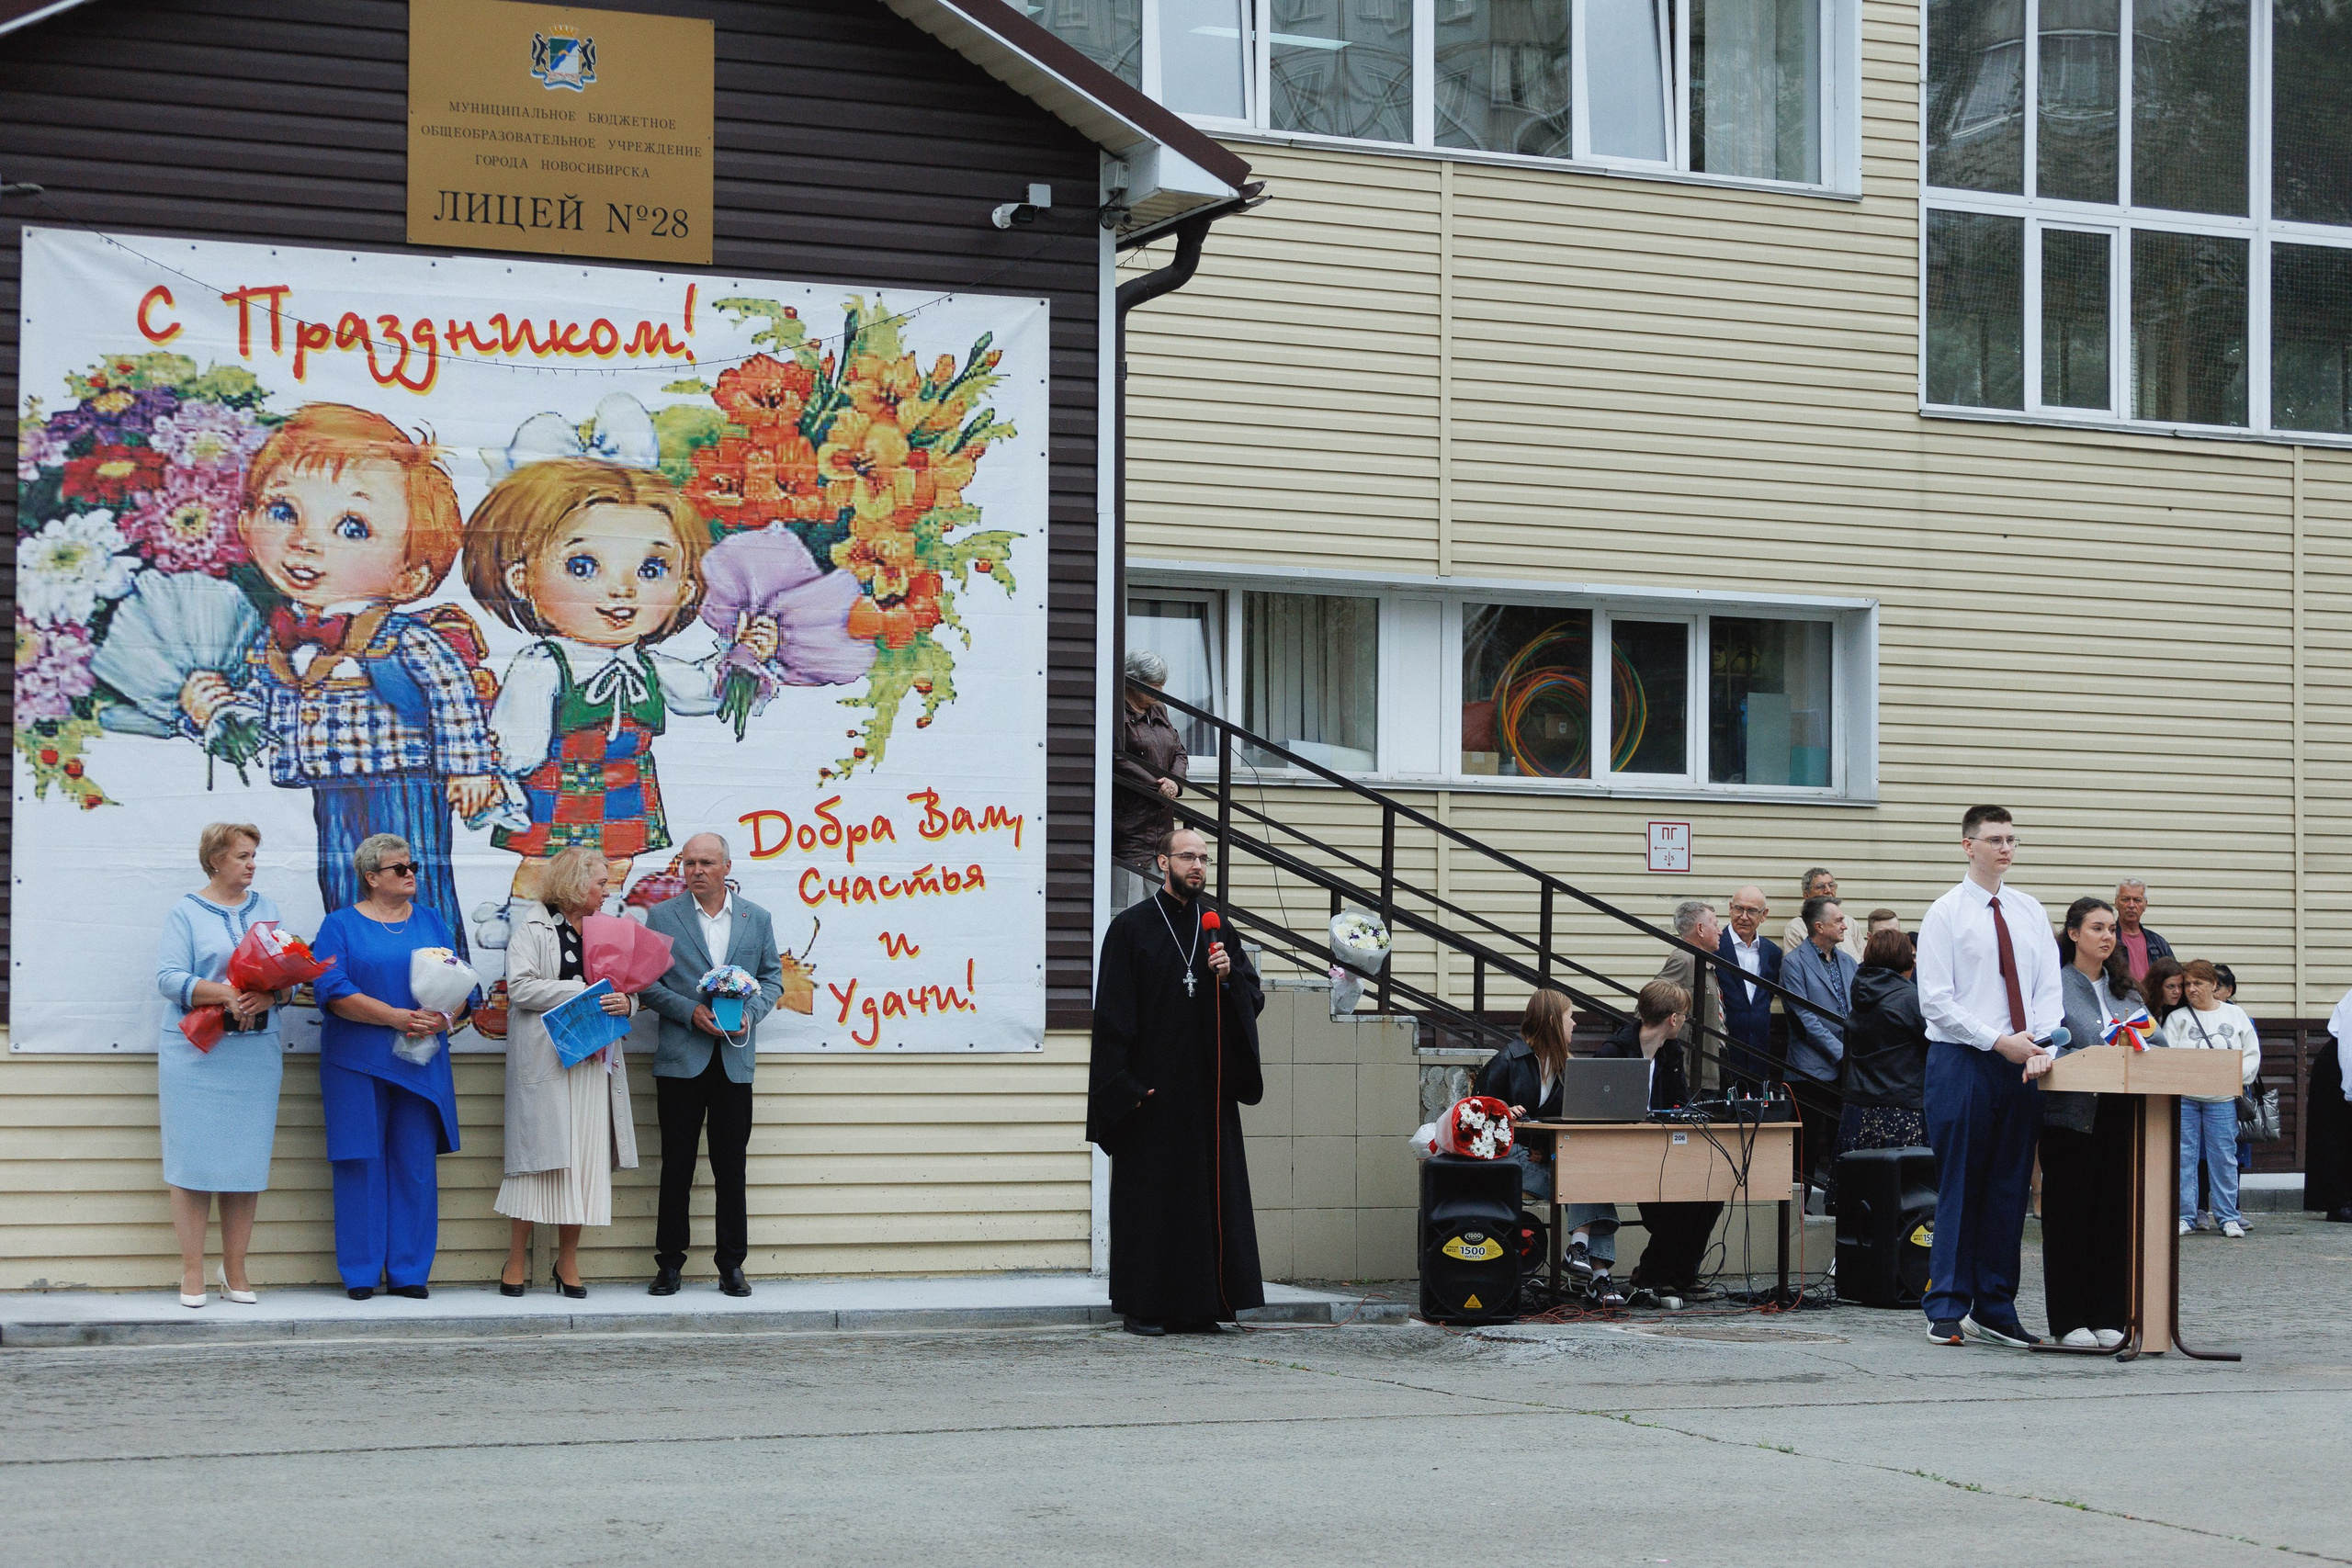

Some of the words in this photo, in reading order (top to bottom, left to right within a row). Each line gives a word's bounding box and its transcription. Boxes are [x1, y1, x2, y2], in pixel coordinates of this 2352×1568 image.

[449, 101, 576, 121] МУНИЦИПАЛЬНОЕ
[588, 112, 676, 130] БЮДЖЕТНОЕ
[421, 125, 596, 149] ОБЩЕОБРАЗОВАТЕЛЬНОЕ
[608, 140, 702, 157] УЧРЕЖДЕНИЕ
[476, 154, 528, 169] ГОРОДА
[541, 160, 650, 178] НОВОСИБИРСКА
[434, 190, 584, 233] ЛИЦЕЙ
[221, 283, 697, 392] Праздником!
[739, 795, 897, 863] Добра
[907, 786, 1023, 850] Вам,
[1662, 828, 1677, 840] ПГ
[878, 931, 921, 959] и
[829, 958, 977, 1047] Удачи!
[1460, 1246, 1486, 1256] 1500
